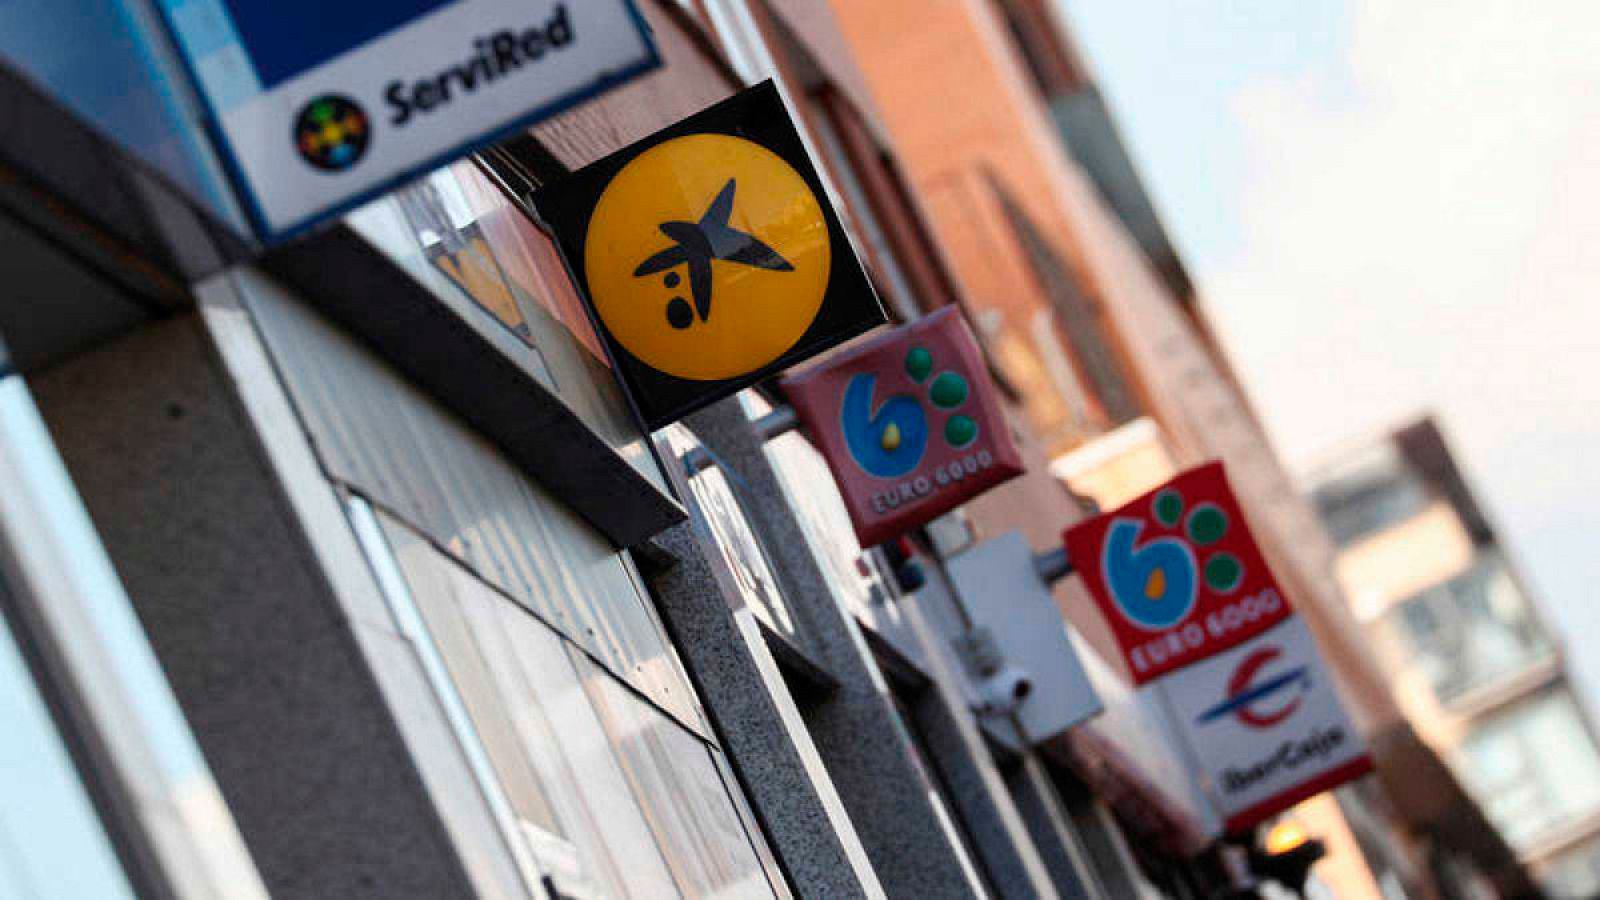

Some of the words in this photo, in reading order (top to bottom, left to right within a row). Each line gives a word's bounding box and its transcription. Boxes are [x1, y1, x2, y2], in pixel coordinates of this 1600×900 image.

[384, 4, 572, 127] ServiRed
[841, 371, 928, 478] 6
[871, 475, 931, 514] EURO
[935, 449, 993, 485] 6000
[1103, 517, 1198, 630] 6
[1131, 624, 1204, 672] EURO
[1206, 588, 1280, 637] 6000
